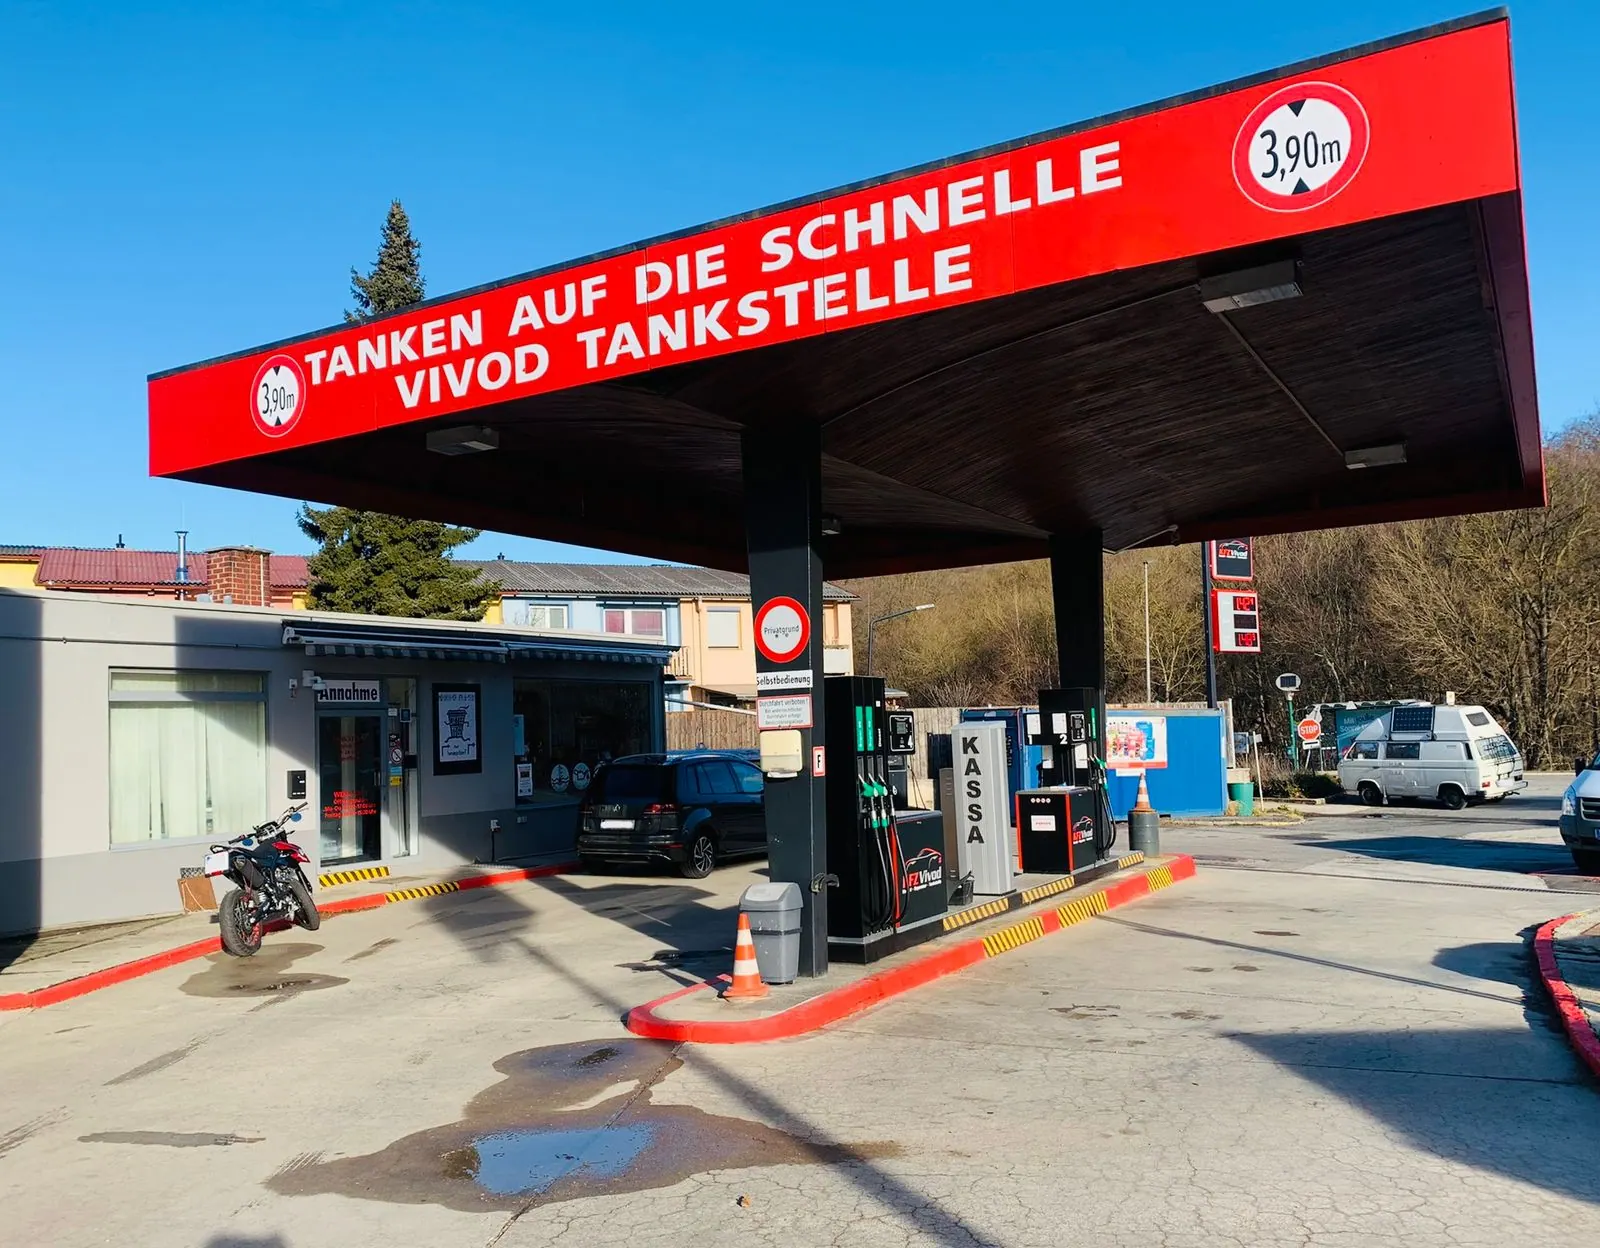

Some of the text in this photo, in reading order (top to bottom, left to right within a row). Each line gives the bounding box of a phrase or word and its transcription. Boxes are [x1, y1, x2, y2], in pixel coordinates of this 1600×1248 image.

[1260, 129, 1341, 182] 3,90m
[304, 141, 1123, 386] TANKEN AUF DIE SCHNELLE
[394, 244, 973, 409] VIVOD TANKSTELLE
[262, 382, 295, 417] 3,90m
[764, 625, 800, 635] Privatgrund
[319, 681, 378, 701] Annahme
[756, 674, 811, 686] Selbstbedienung
[1059, 733, 1068, 745] 2
[1299, 724, 1319, 735] STOP
[961, 736, 985, 844] KASSA
